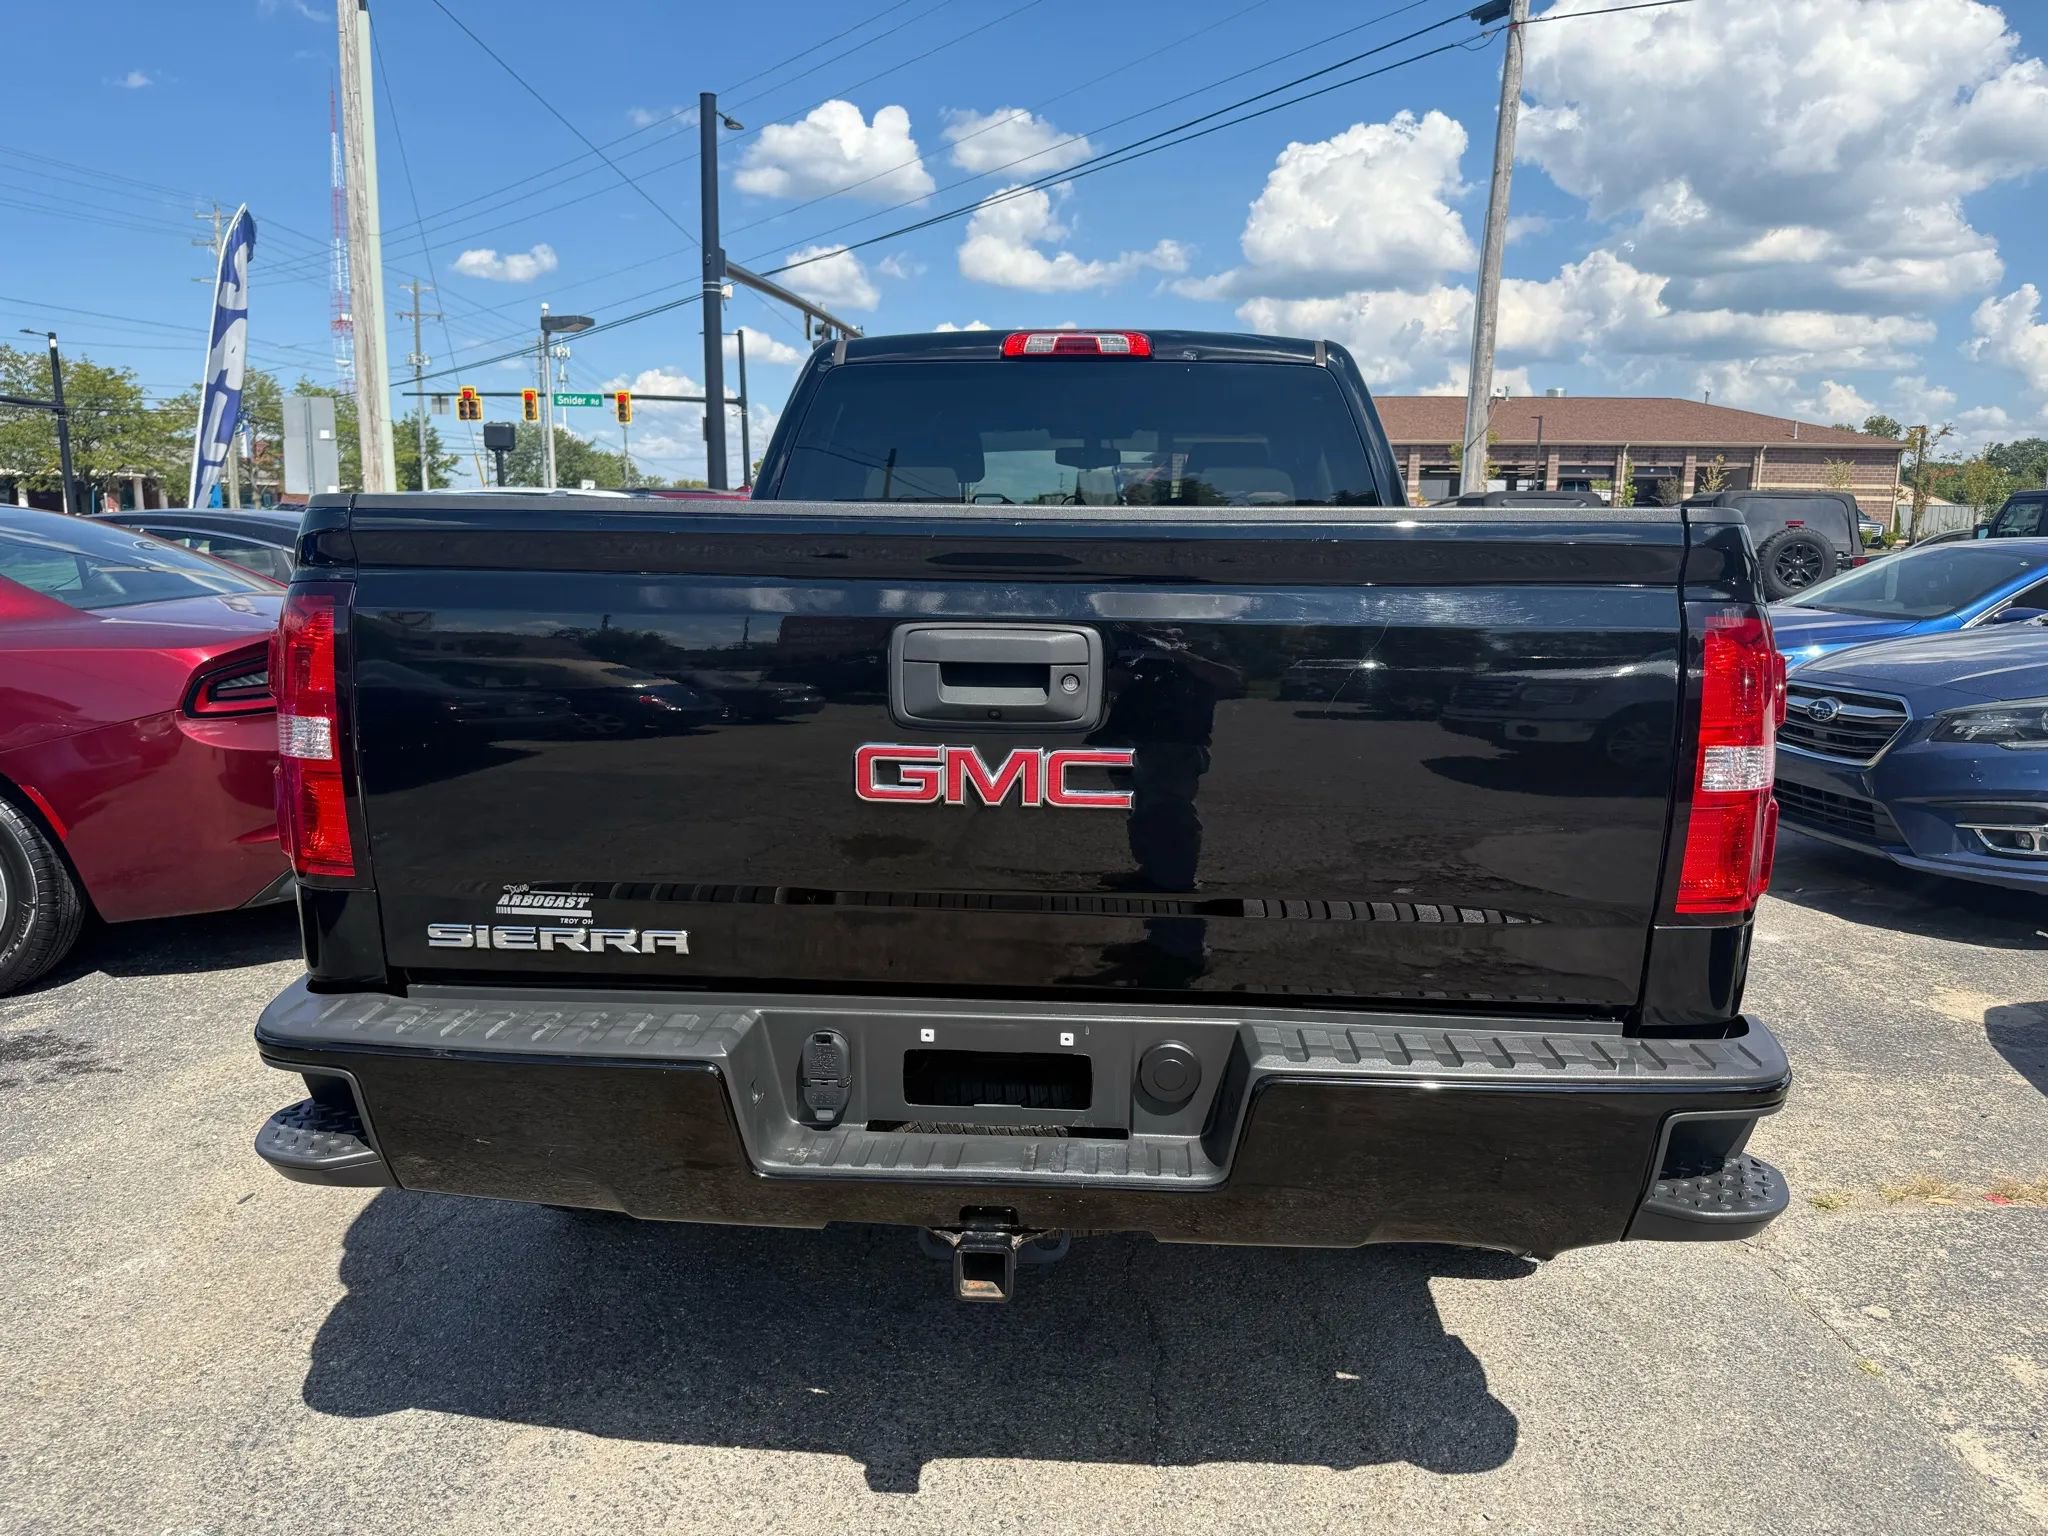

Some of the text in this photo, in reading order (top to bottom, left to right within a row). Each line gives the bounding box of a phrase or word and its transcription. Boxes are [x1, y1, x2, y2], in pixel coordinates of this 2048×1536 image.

[557, 395, 600, 406] Snider Rd
[855, 744, 1135, 809] GMC
[503, 884, 529, 895] Dave
[497, 894, 590, 908] ARBOGAST
[427, 923, 689, 955] SIERRA
